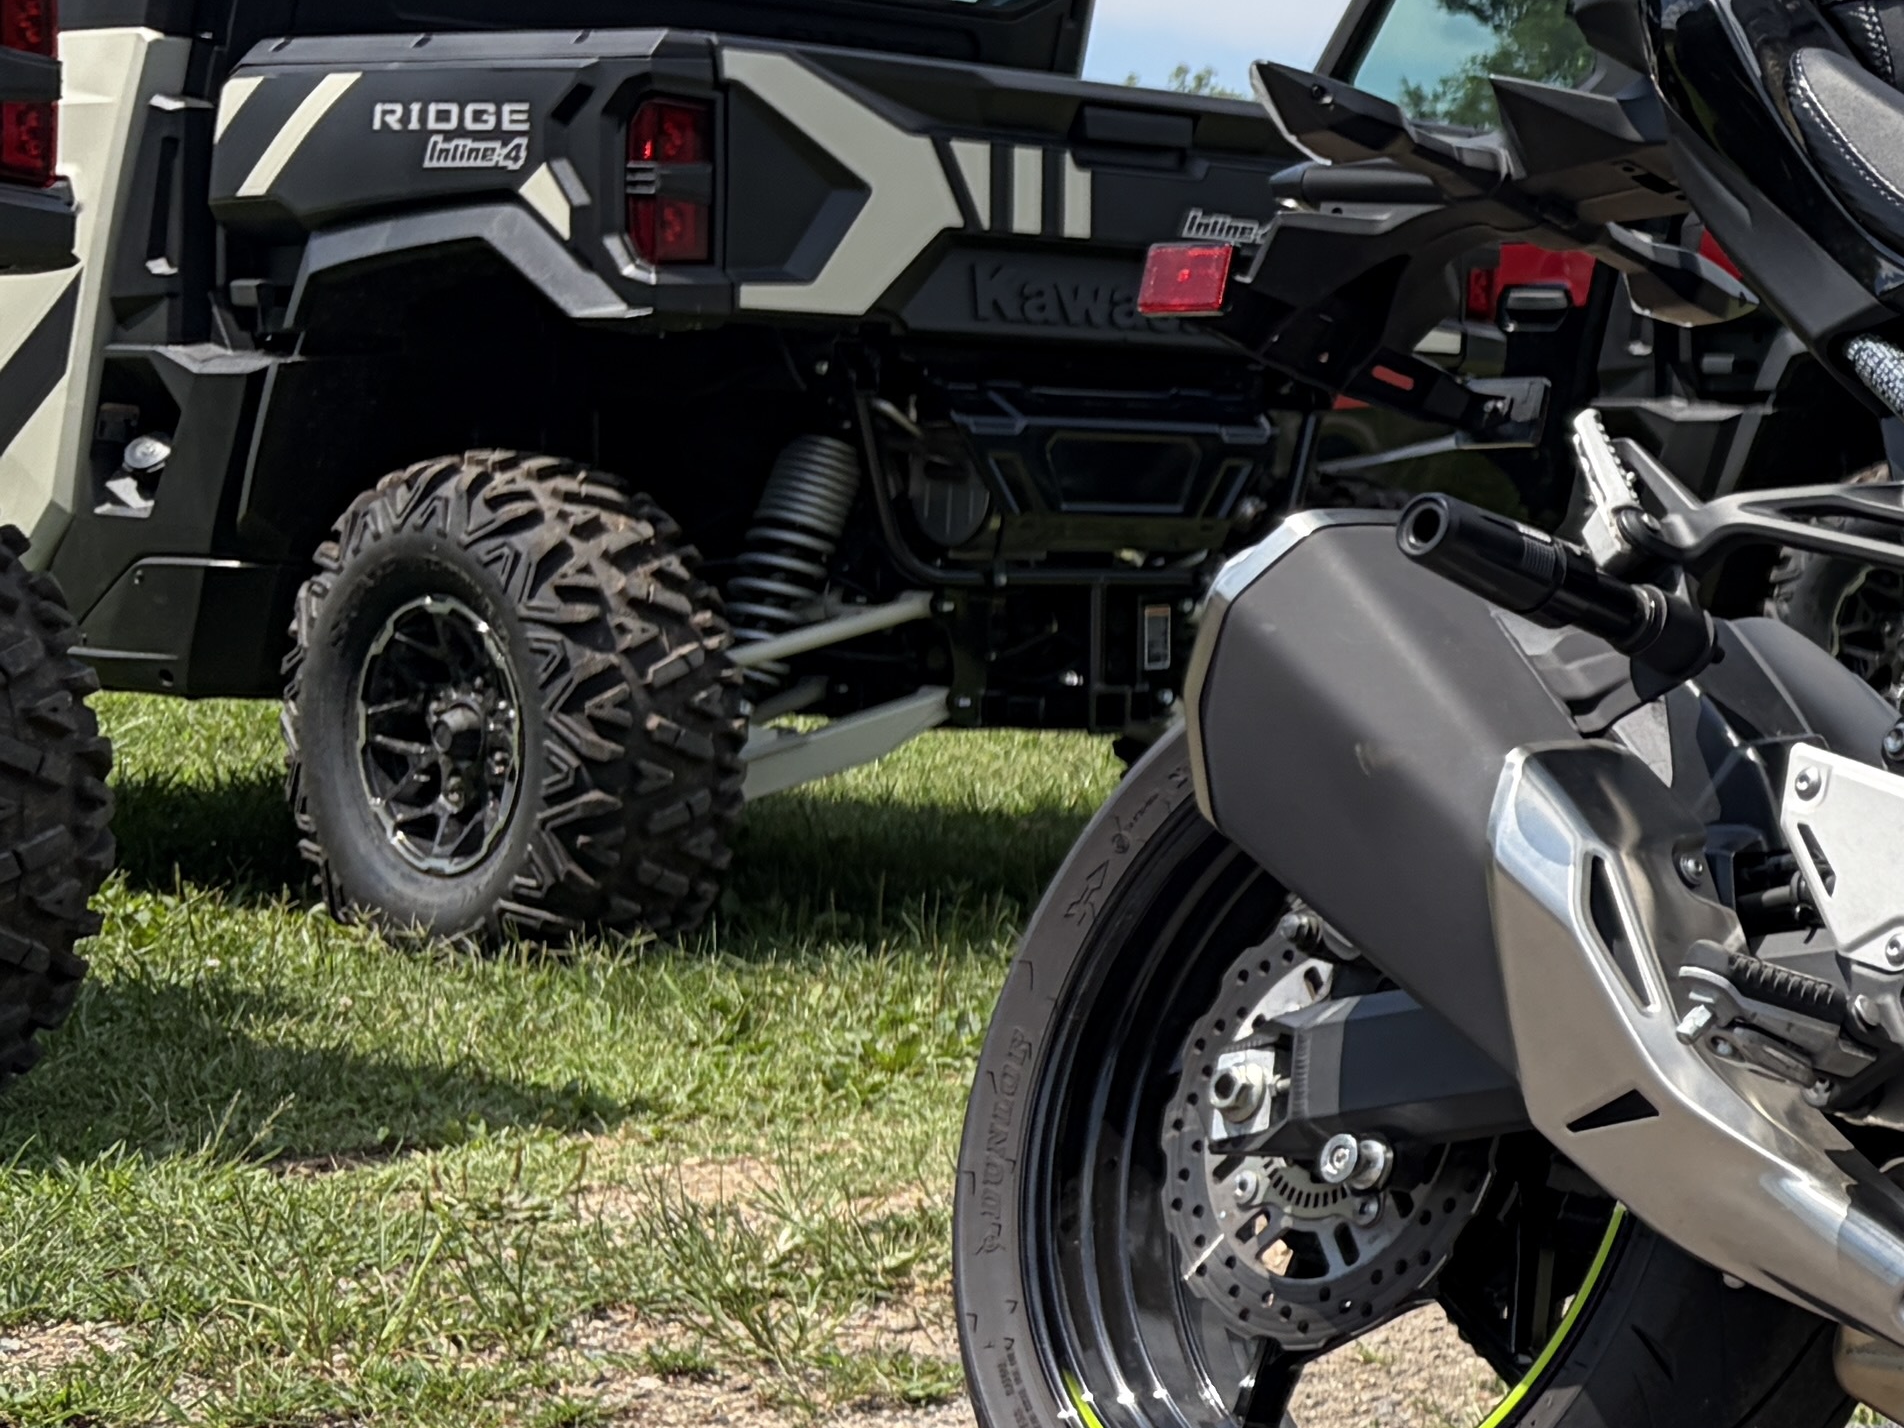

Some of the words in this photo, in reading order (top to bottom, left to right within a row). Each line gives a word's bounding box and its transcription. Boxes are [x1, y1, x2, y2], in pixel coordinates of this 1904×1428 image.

[372, 102, 531, 133] RIDGE
[422, 135, 529, 170] Inline-4
[1182, 208, 1260, 243] Inline
[967, 263, 1180, 334] Kawa
